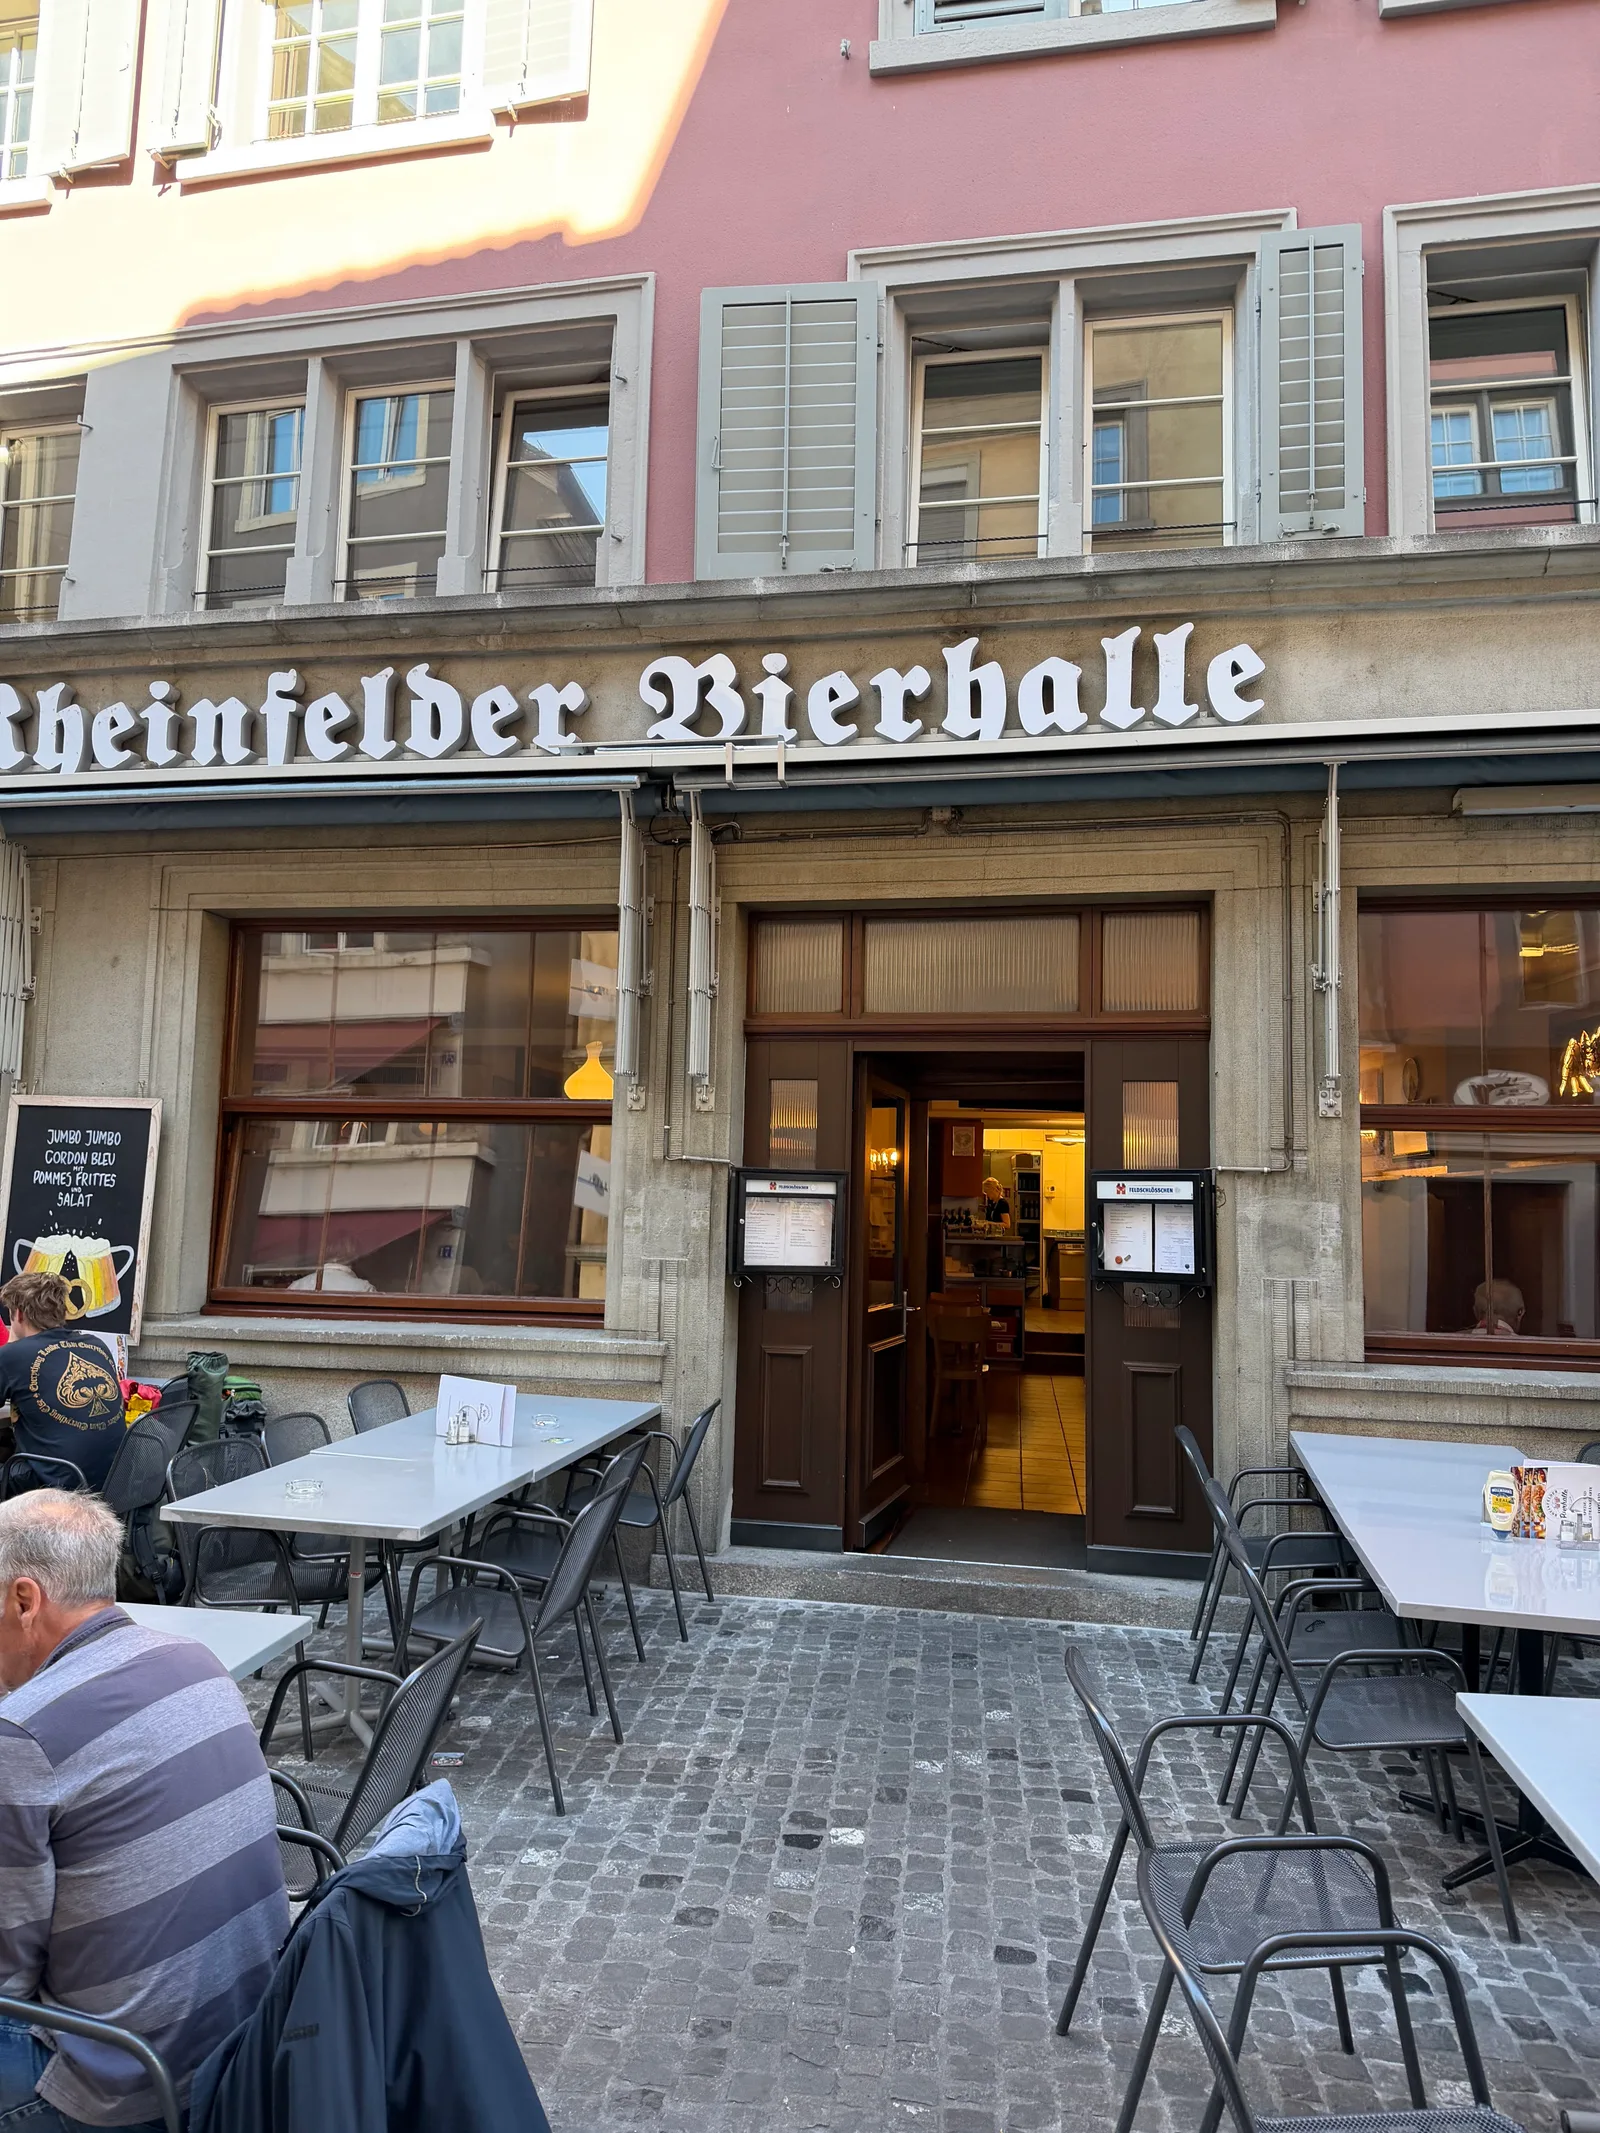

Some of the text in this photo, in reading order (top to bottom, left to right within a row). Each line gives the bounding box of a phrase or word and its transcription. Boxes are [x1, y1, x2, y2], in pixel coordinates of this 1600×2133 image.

[639, 621, 1266, 746] Bierhalle
[46, 1129, 122, 1146] JUMBO JUMBO
[45, 1150, 116, 1166] CORDON BLEU
[33, 1170, 117, 1187] POMMES FRITTES
[57, 1192, 94, 1207] SALAT
